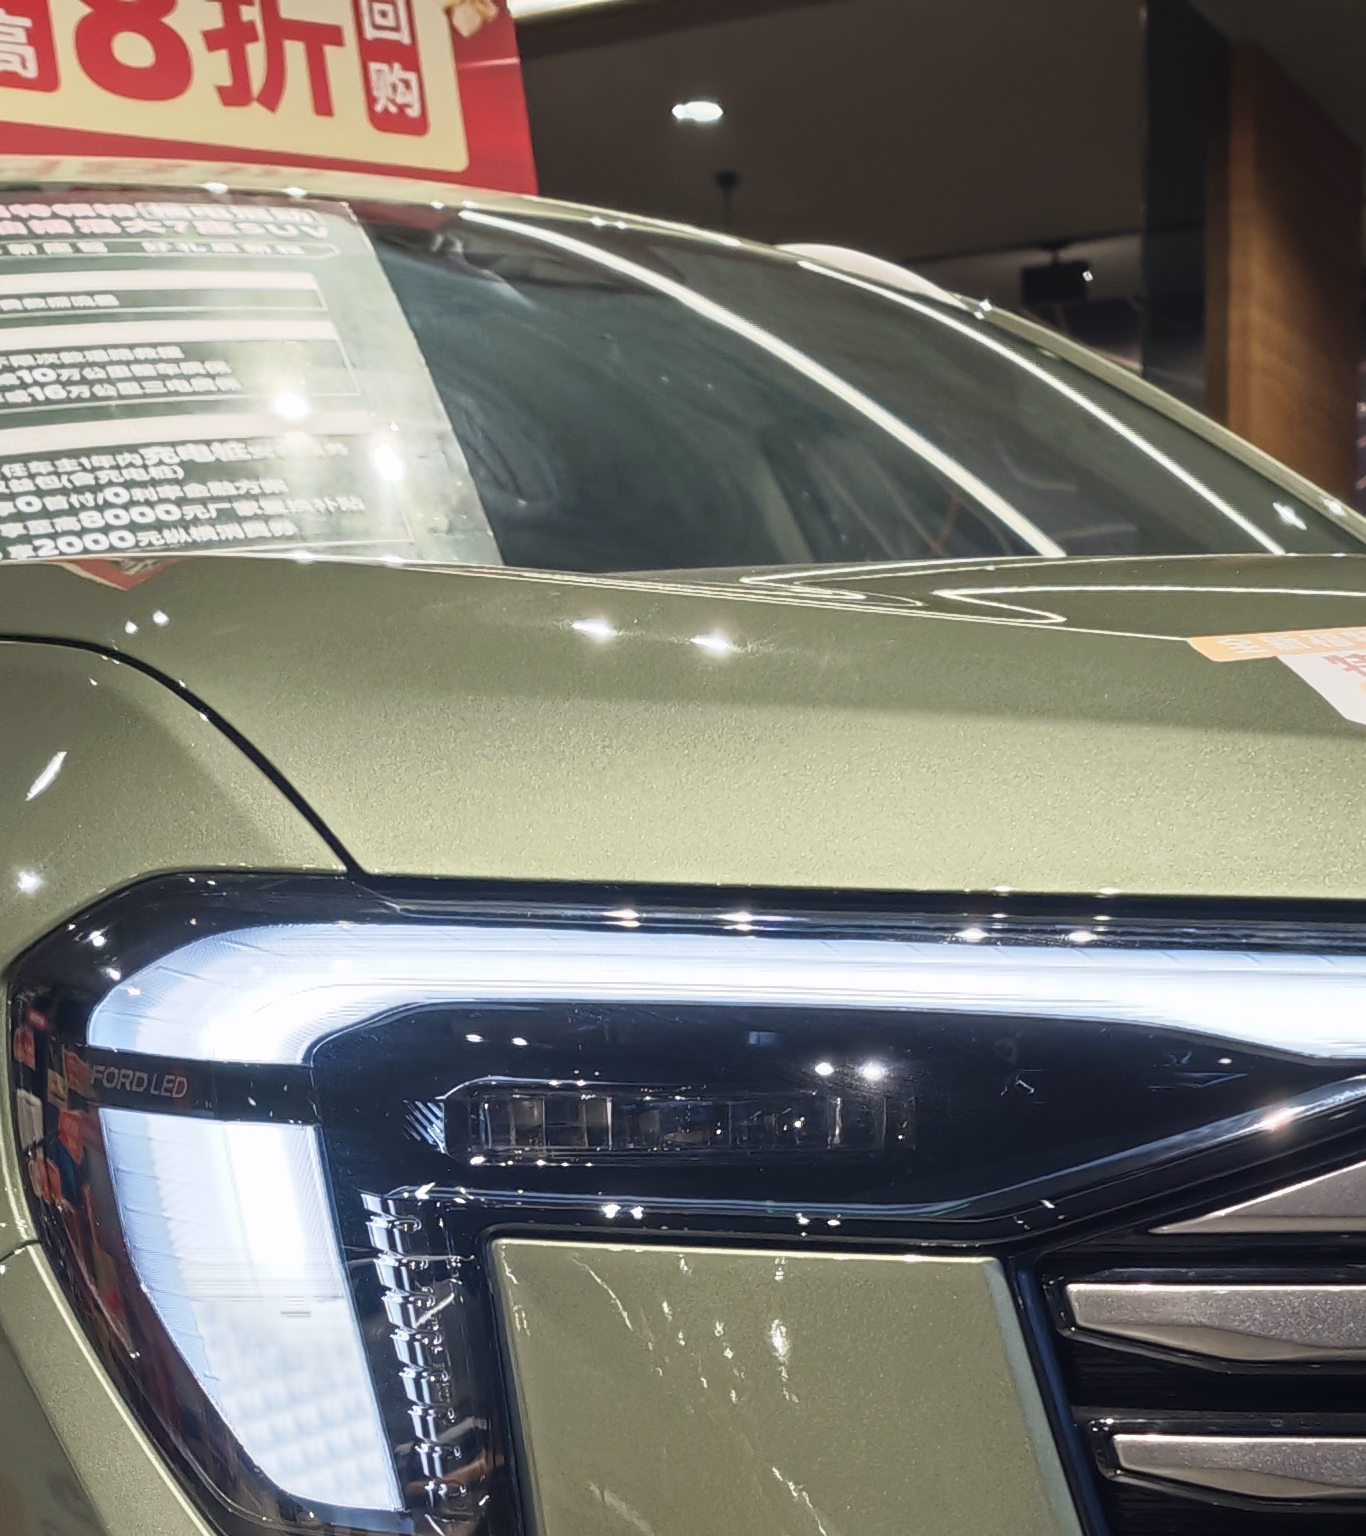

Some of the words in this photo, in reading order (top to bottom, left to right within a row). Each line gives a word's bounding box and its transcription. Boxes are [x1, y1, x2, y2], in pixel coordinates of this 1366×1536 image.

[355, 0, 422, 118] 回购
[90, 1064, 149, 1093] FORD
[150, 1073, 188, 1099] LED
